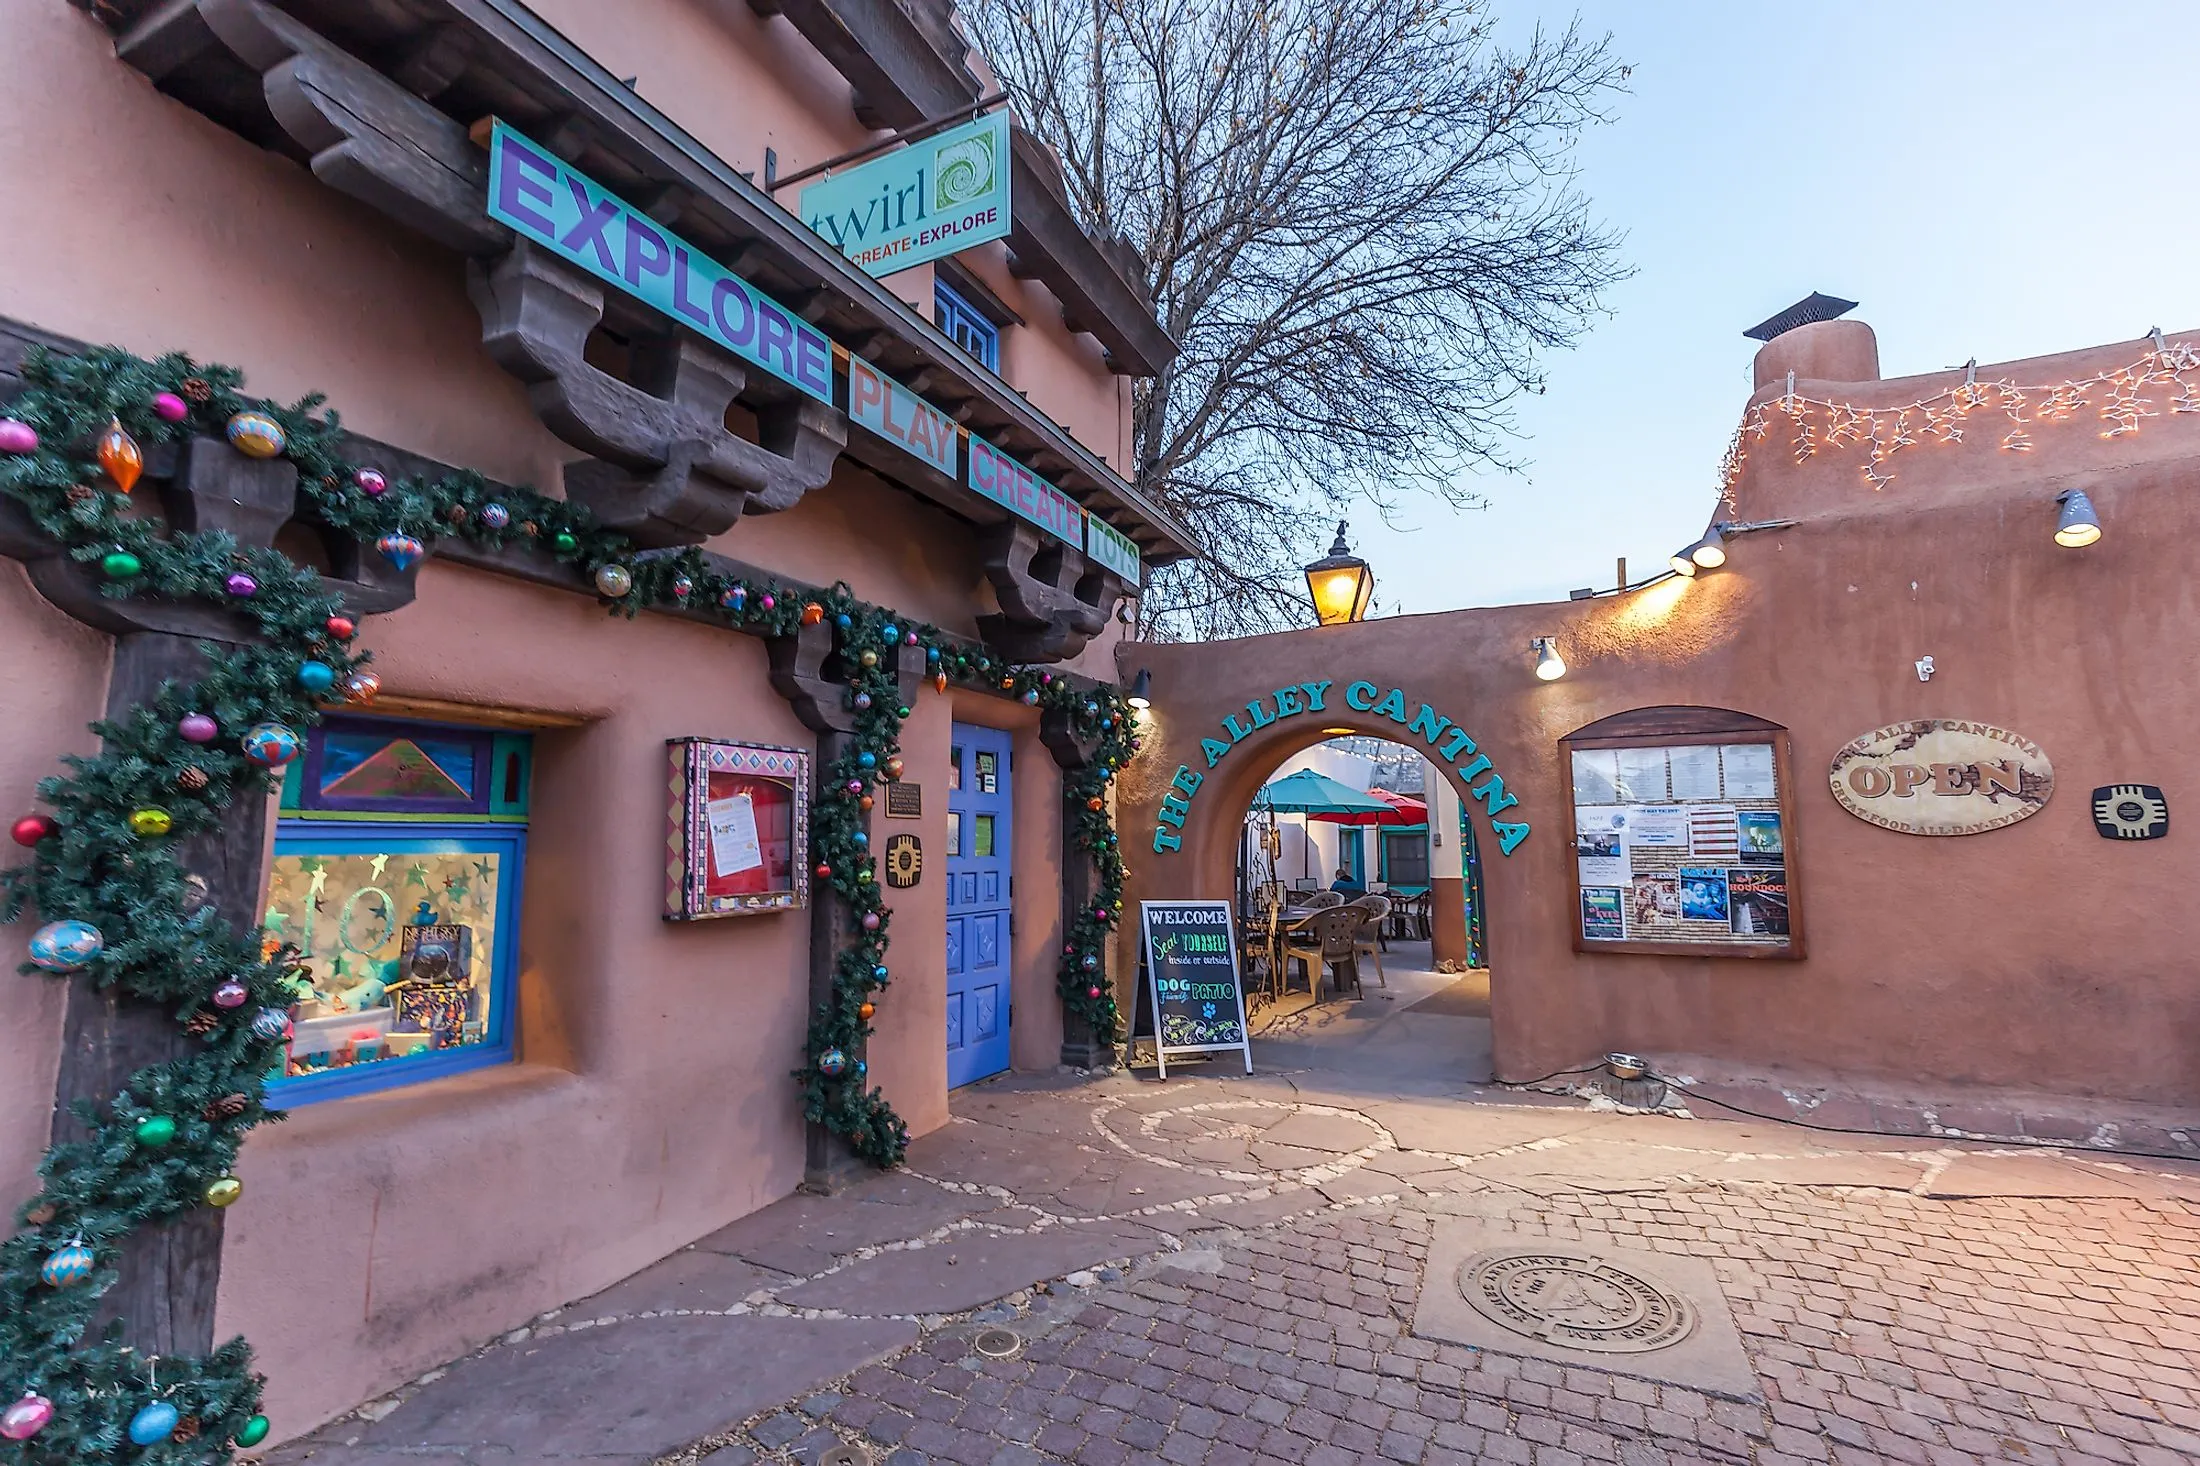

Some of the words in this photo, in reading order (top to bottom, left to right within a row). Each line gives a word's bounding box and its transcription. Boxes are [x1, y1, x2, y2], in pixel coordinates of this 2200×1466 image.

[809, 168, 927, 243] twirl
[498, 133, 828, 397] EXPLORE
[851, 236, 911, 266] CREATE
[919, 206, 998, 246] EXPLORE
[854, 362, 954, 465] PLAY
[973, 443, 1081, 543] CREATE
[1090, 517, 1138, 578] TOYS
[1153, 763, 1204, 855] THE
[1200, 679, 1334, 769] ALLEY
[1345, 680, 1531, 857] CANTINA
[1942, 721, 2040, 759] CANTINA
[1831, 780, 1868, 817] GREAT
[1869, 813, 1911, 832] FOOD
[1917, 826, 1949, 835] ALL
[1951, 823, 1984, 834] DAY
[1850, 760, 2025, 798] OPEN
[1149, 910, 1227, 925] WELCOME
[1181, 933, 1228, 952] YOURSELF
[1158, 978, 1191, 992] DOG
[1192, 983, 1235, 1000] PATIO
